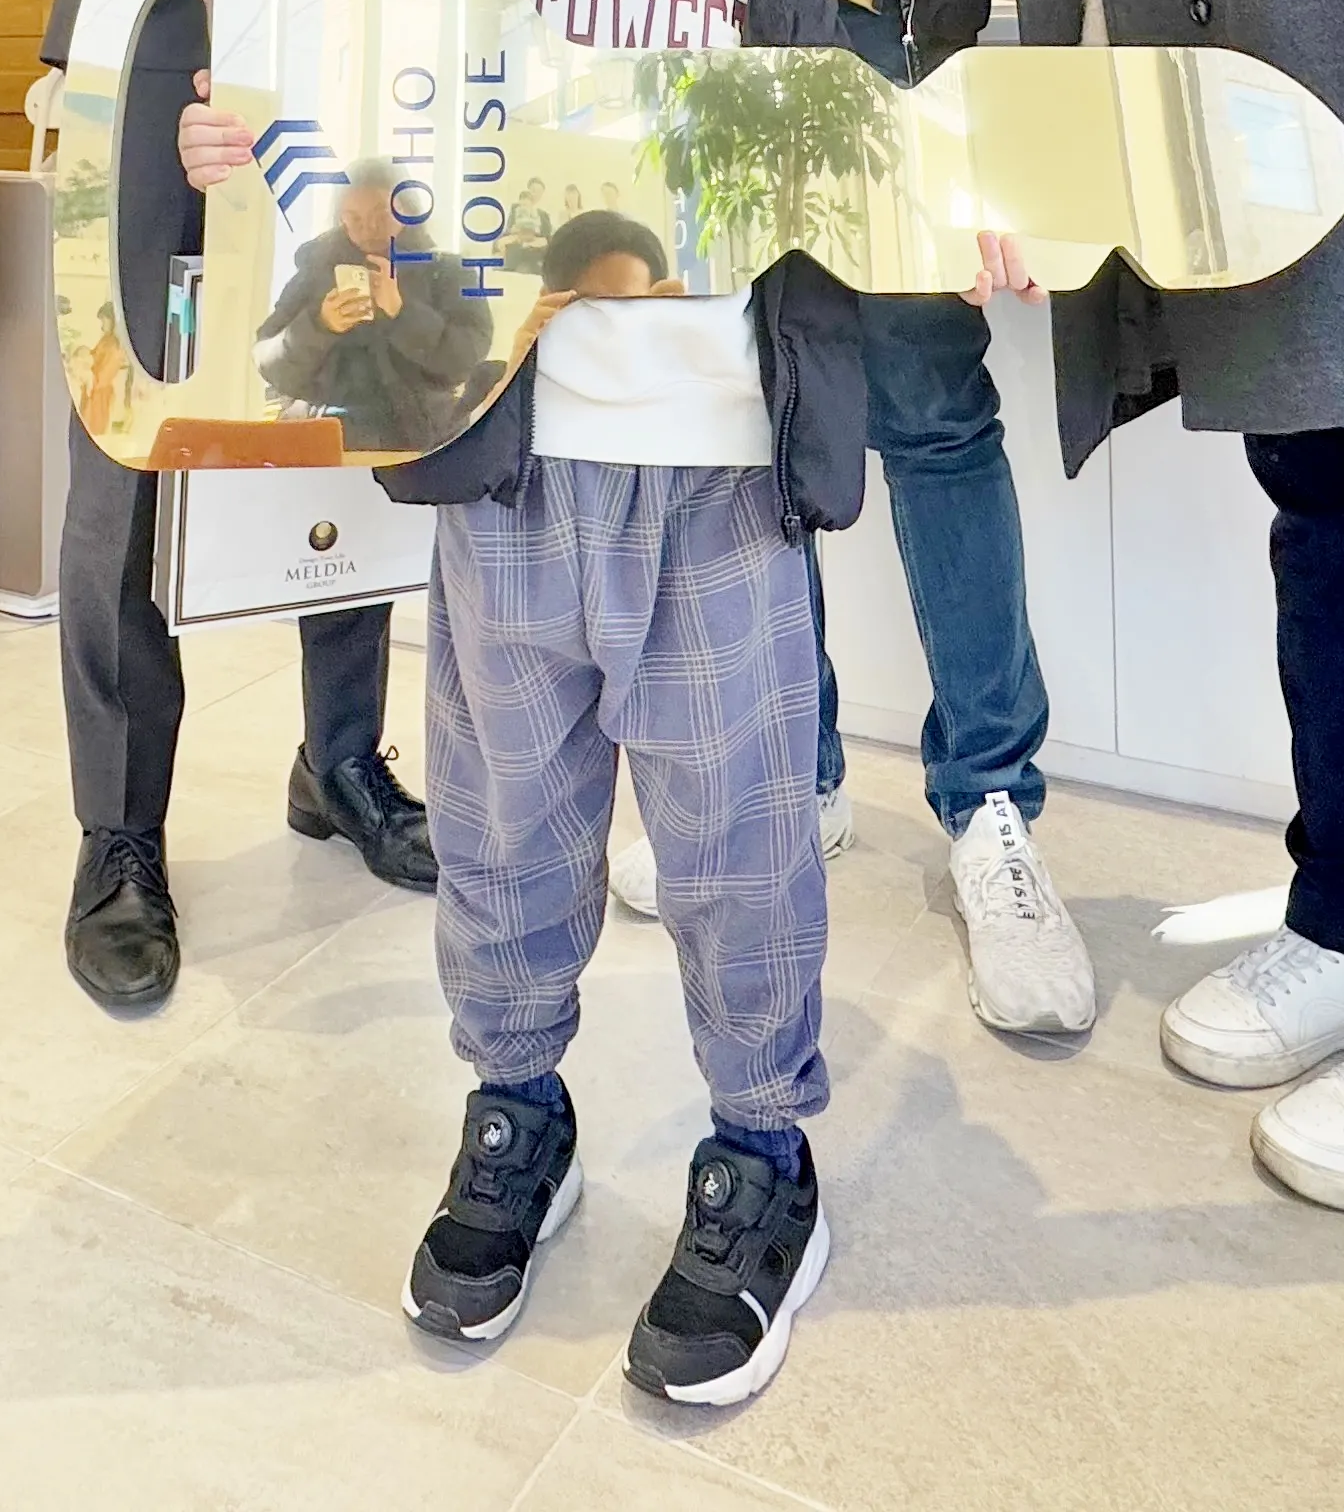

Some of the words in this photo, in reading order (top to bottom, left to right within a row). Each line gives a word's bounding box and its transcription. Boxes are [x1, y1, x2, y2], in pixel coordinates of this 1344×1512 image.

[390, 66, 436, 279] TOHO
[460, 50, 506, 297] HOUSE
[284, 560, 357, 582] MELDIA
